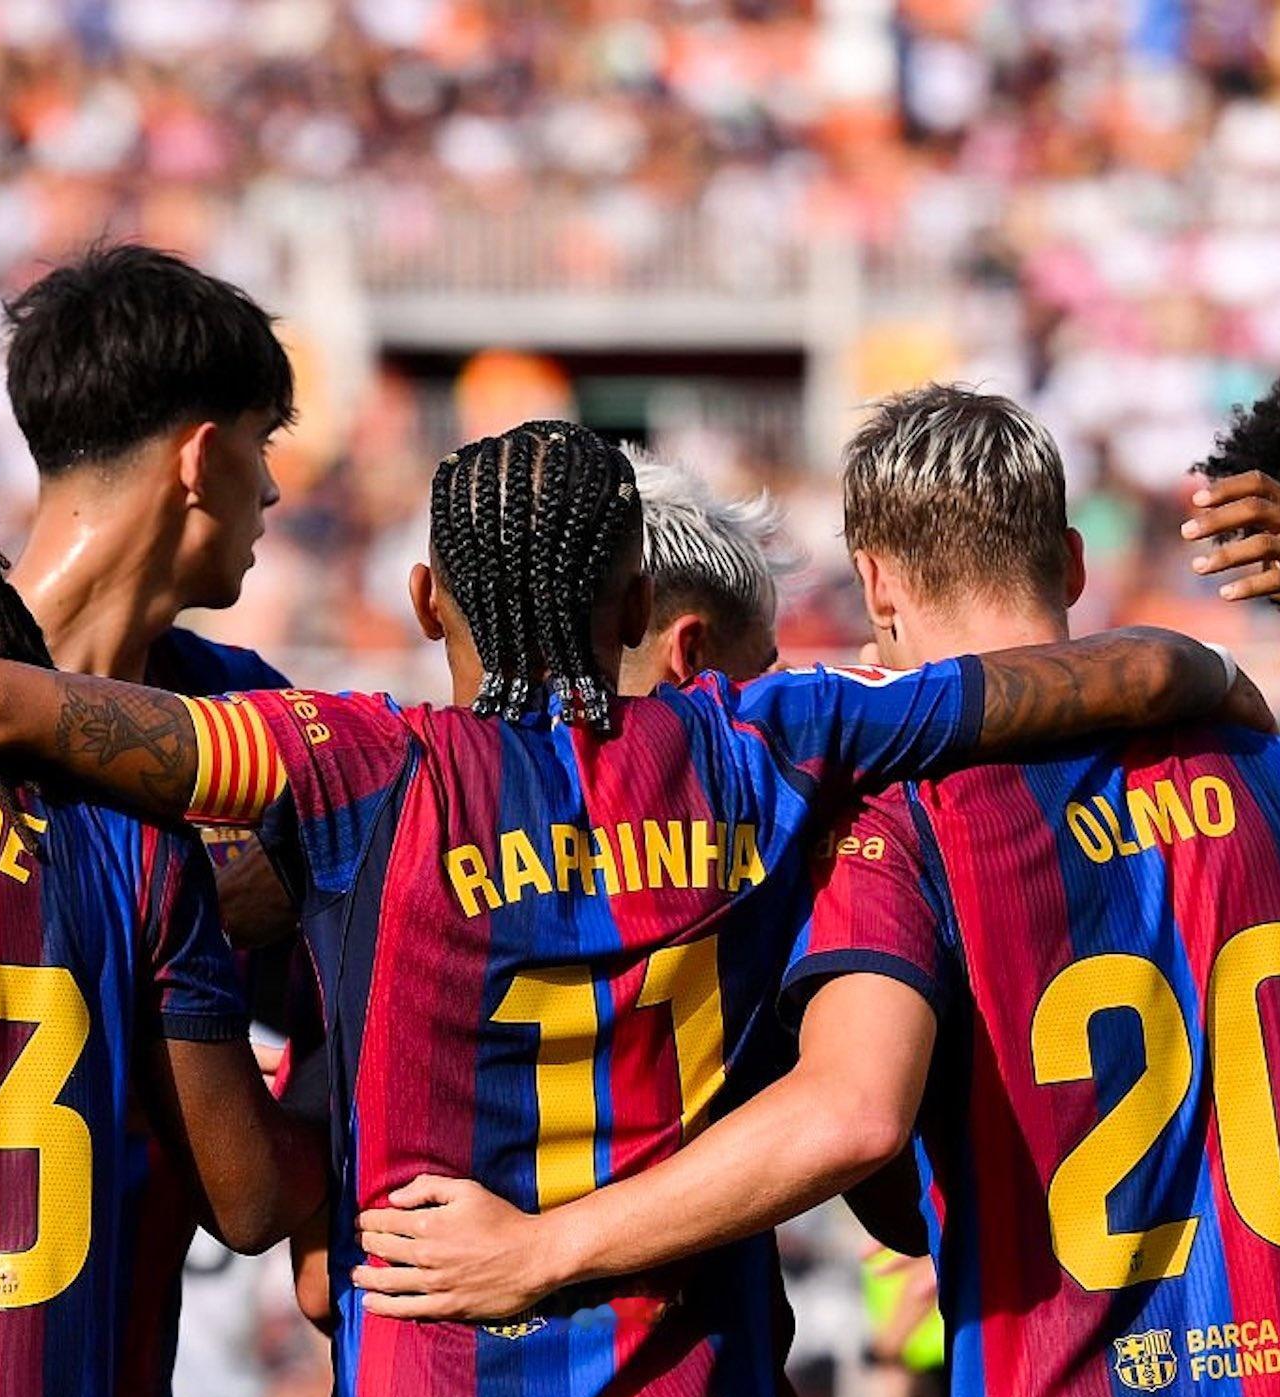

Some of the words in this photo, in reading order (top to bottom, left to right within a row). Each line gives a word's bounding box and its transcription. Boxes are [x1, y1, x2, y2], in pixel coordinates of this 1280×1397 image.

[279, 689, 331, 746] dea
[1065, 775, 1237, 864] OLMO
[443, 819, 767, 919] RAPHINHA
[489, 933, 727, 1215] 11
[1186, 1318, 1280, 1353] BARÇA
